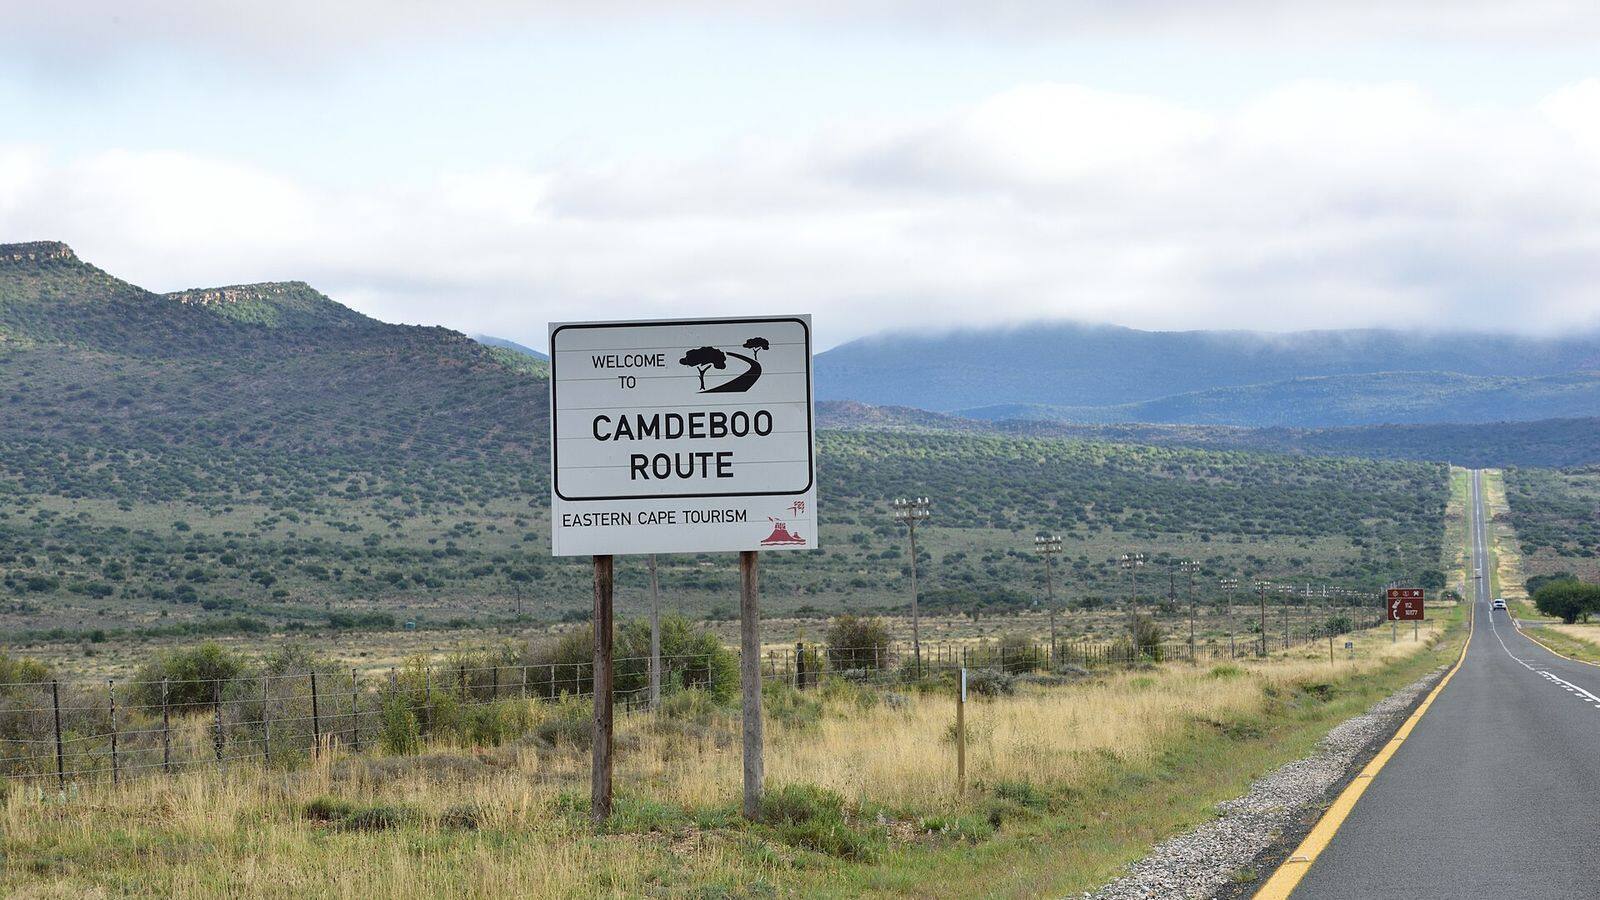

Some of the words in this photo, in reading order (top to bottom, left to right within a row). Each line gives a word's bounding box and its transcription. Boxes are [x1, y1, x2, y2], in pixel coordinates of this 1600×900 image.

[592, 354, 666, 369] WELCOME
[618, 375, 637, 389] TO
[592, 410, 773, 442] CAMDEBOO
[630, 452, 734, 480] ROUTE
[562, 512, 632, 527] EASTERN
[637, 511, 677, 525] CAPE
[682, 509, 747, 524] TOURISM
